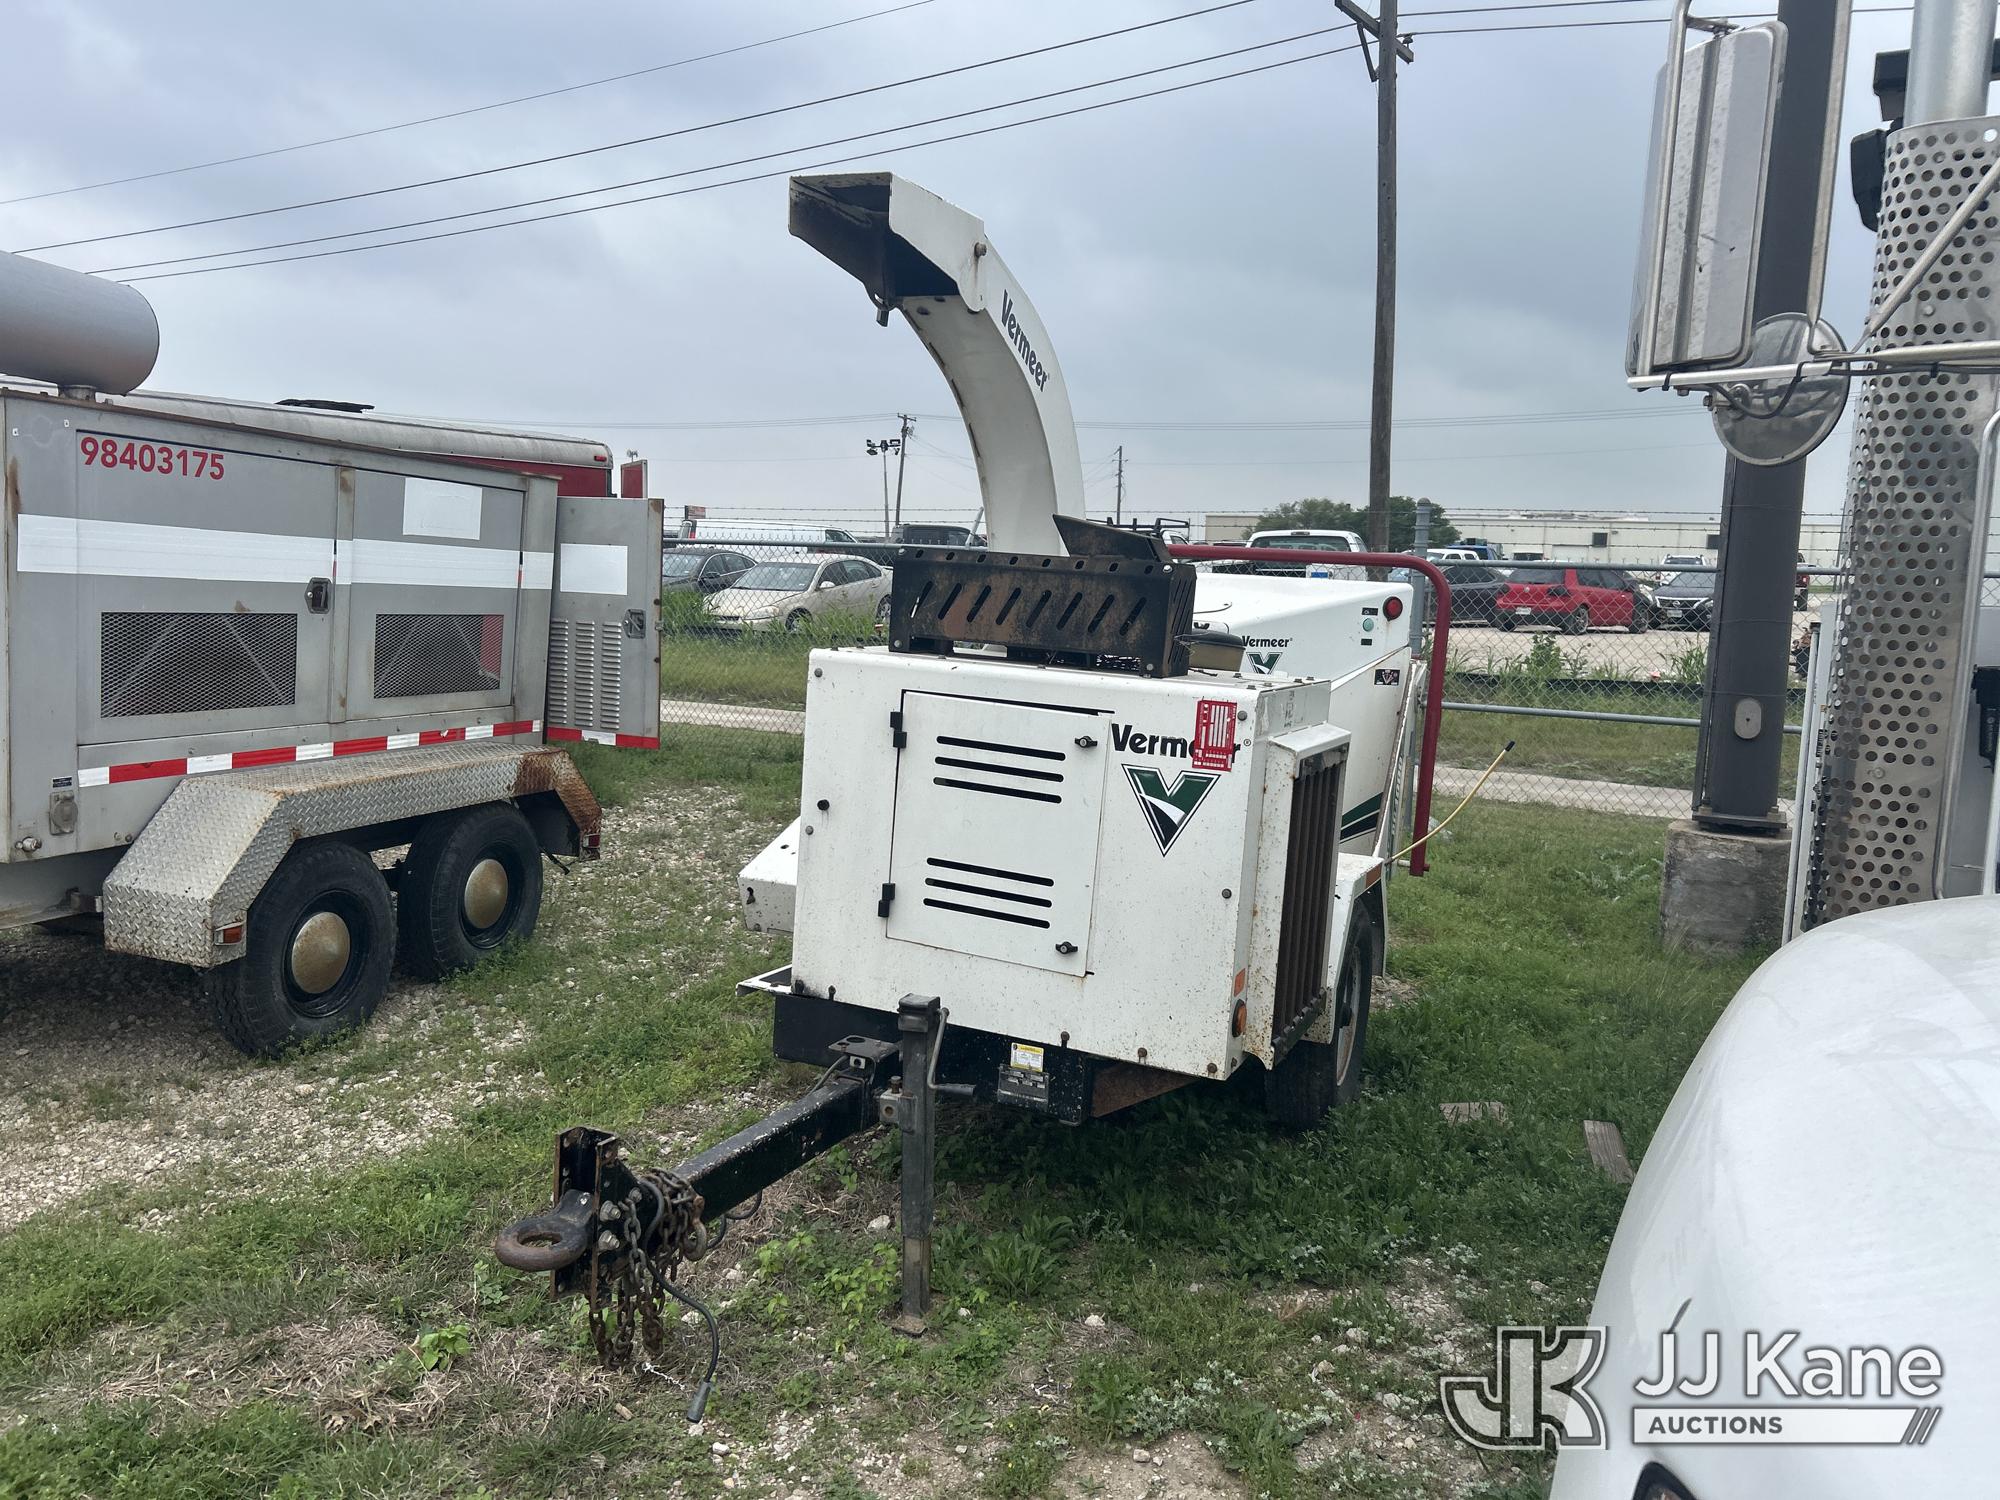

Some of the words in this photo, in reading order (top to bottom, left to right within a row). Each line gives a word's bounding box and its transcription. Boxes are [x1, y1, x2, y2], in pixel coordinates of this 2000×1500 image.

[1001, 288, 1047, 392] Vermeer
[80, 436, 225, 480] 98403175
[1241, 635, 1290, 648] Vermeer
[1111, 722, 1241, 764] Vermr
